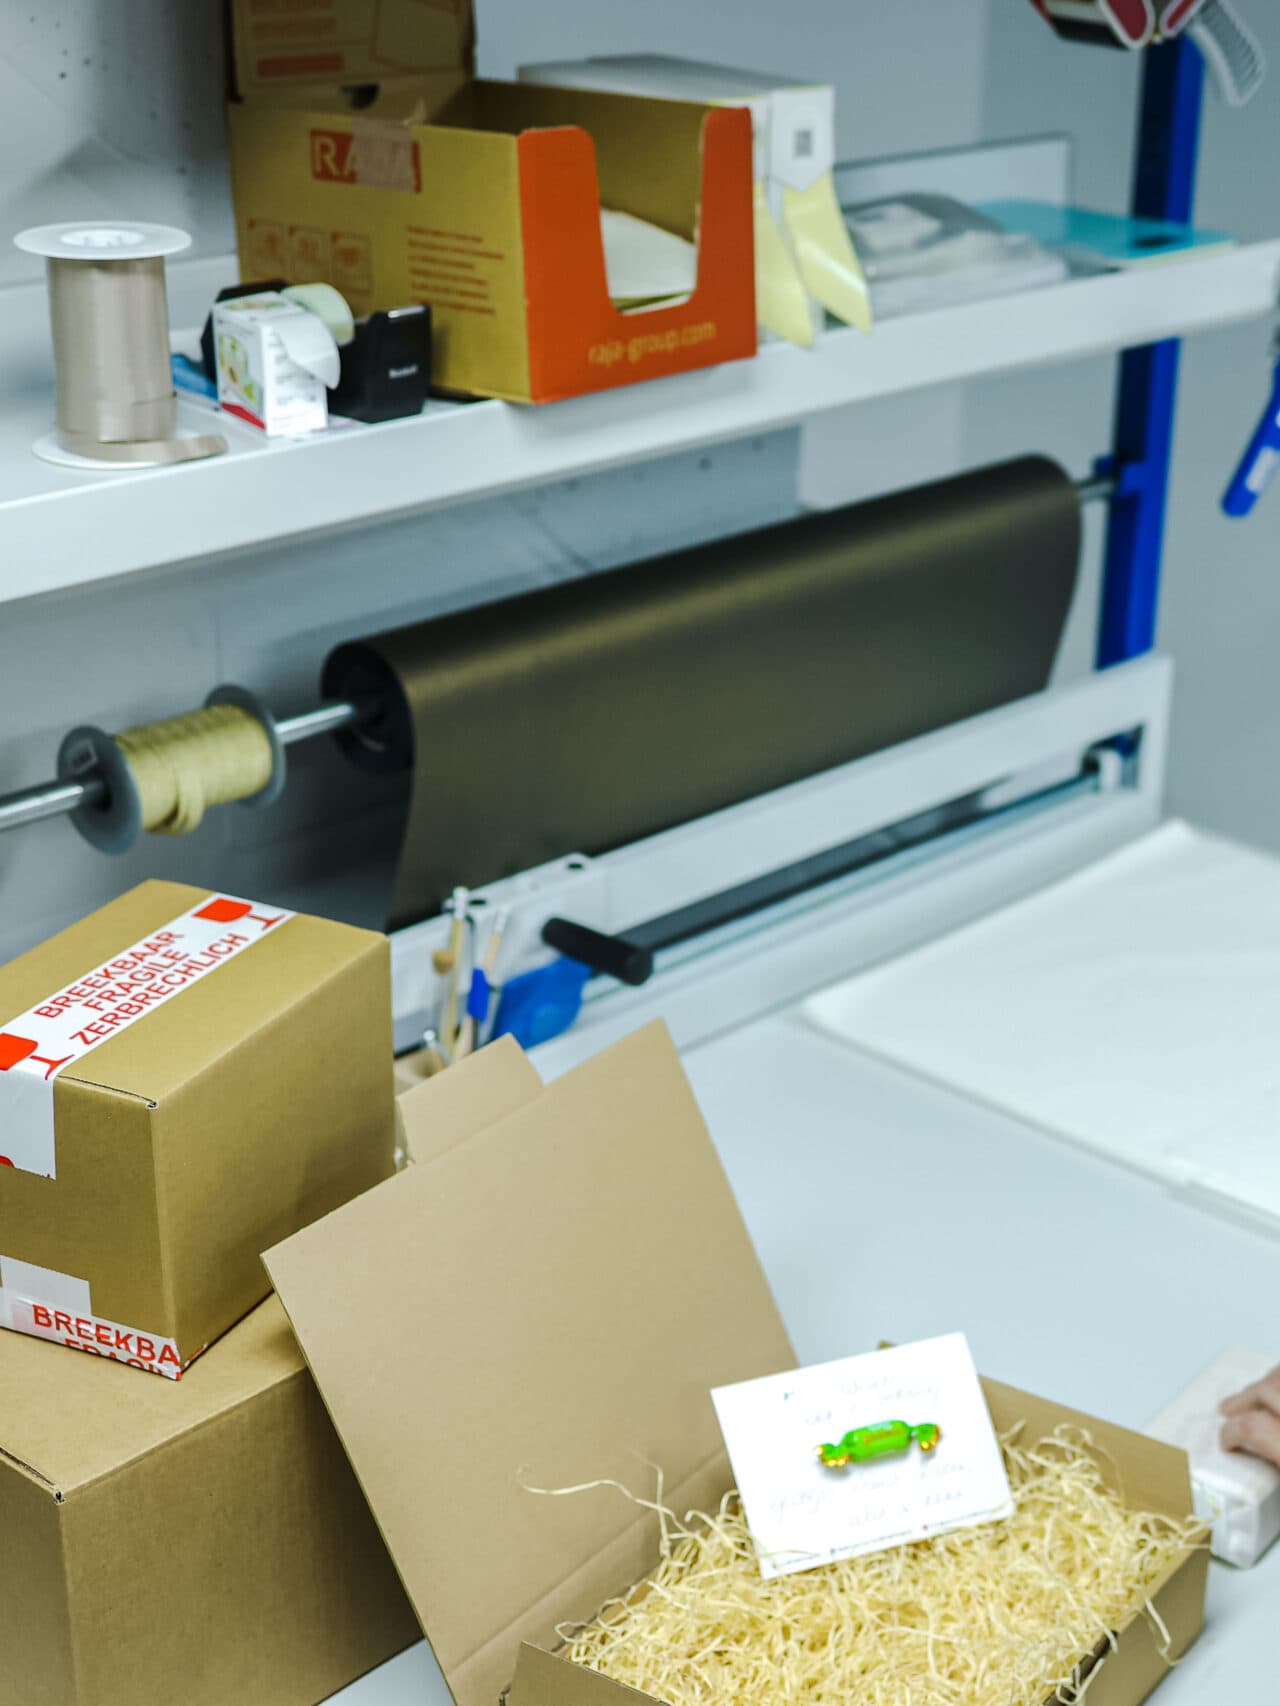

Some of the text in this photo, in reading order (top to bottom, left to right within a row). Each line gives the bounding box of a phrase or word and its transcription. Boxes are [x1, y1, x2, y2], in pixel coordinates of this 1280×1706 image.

[588, 321, 716, 367] raja-group.com
[33, 930, 185, 1018] BREEKBAAR
[68, 932, 249, 1045] ZERBRECHLICH
[82, 949, 190, 1011] FRAGILE
